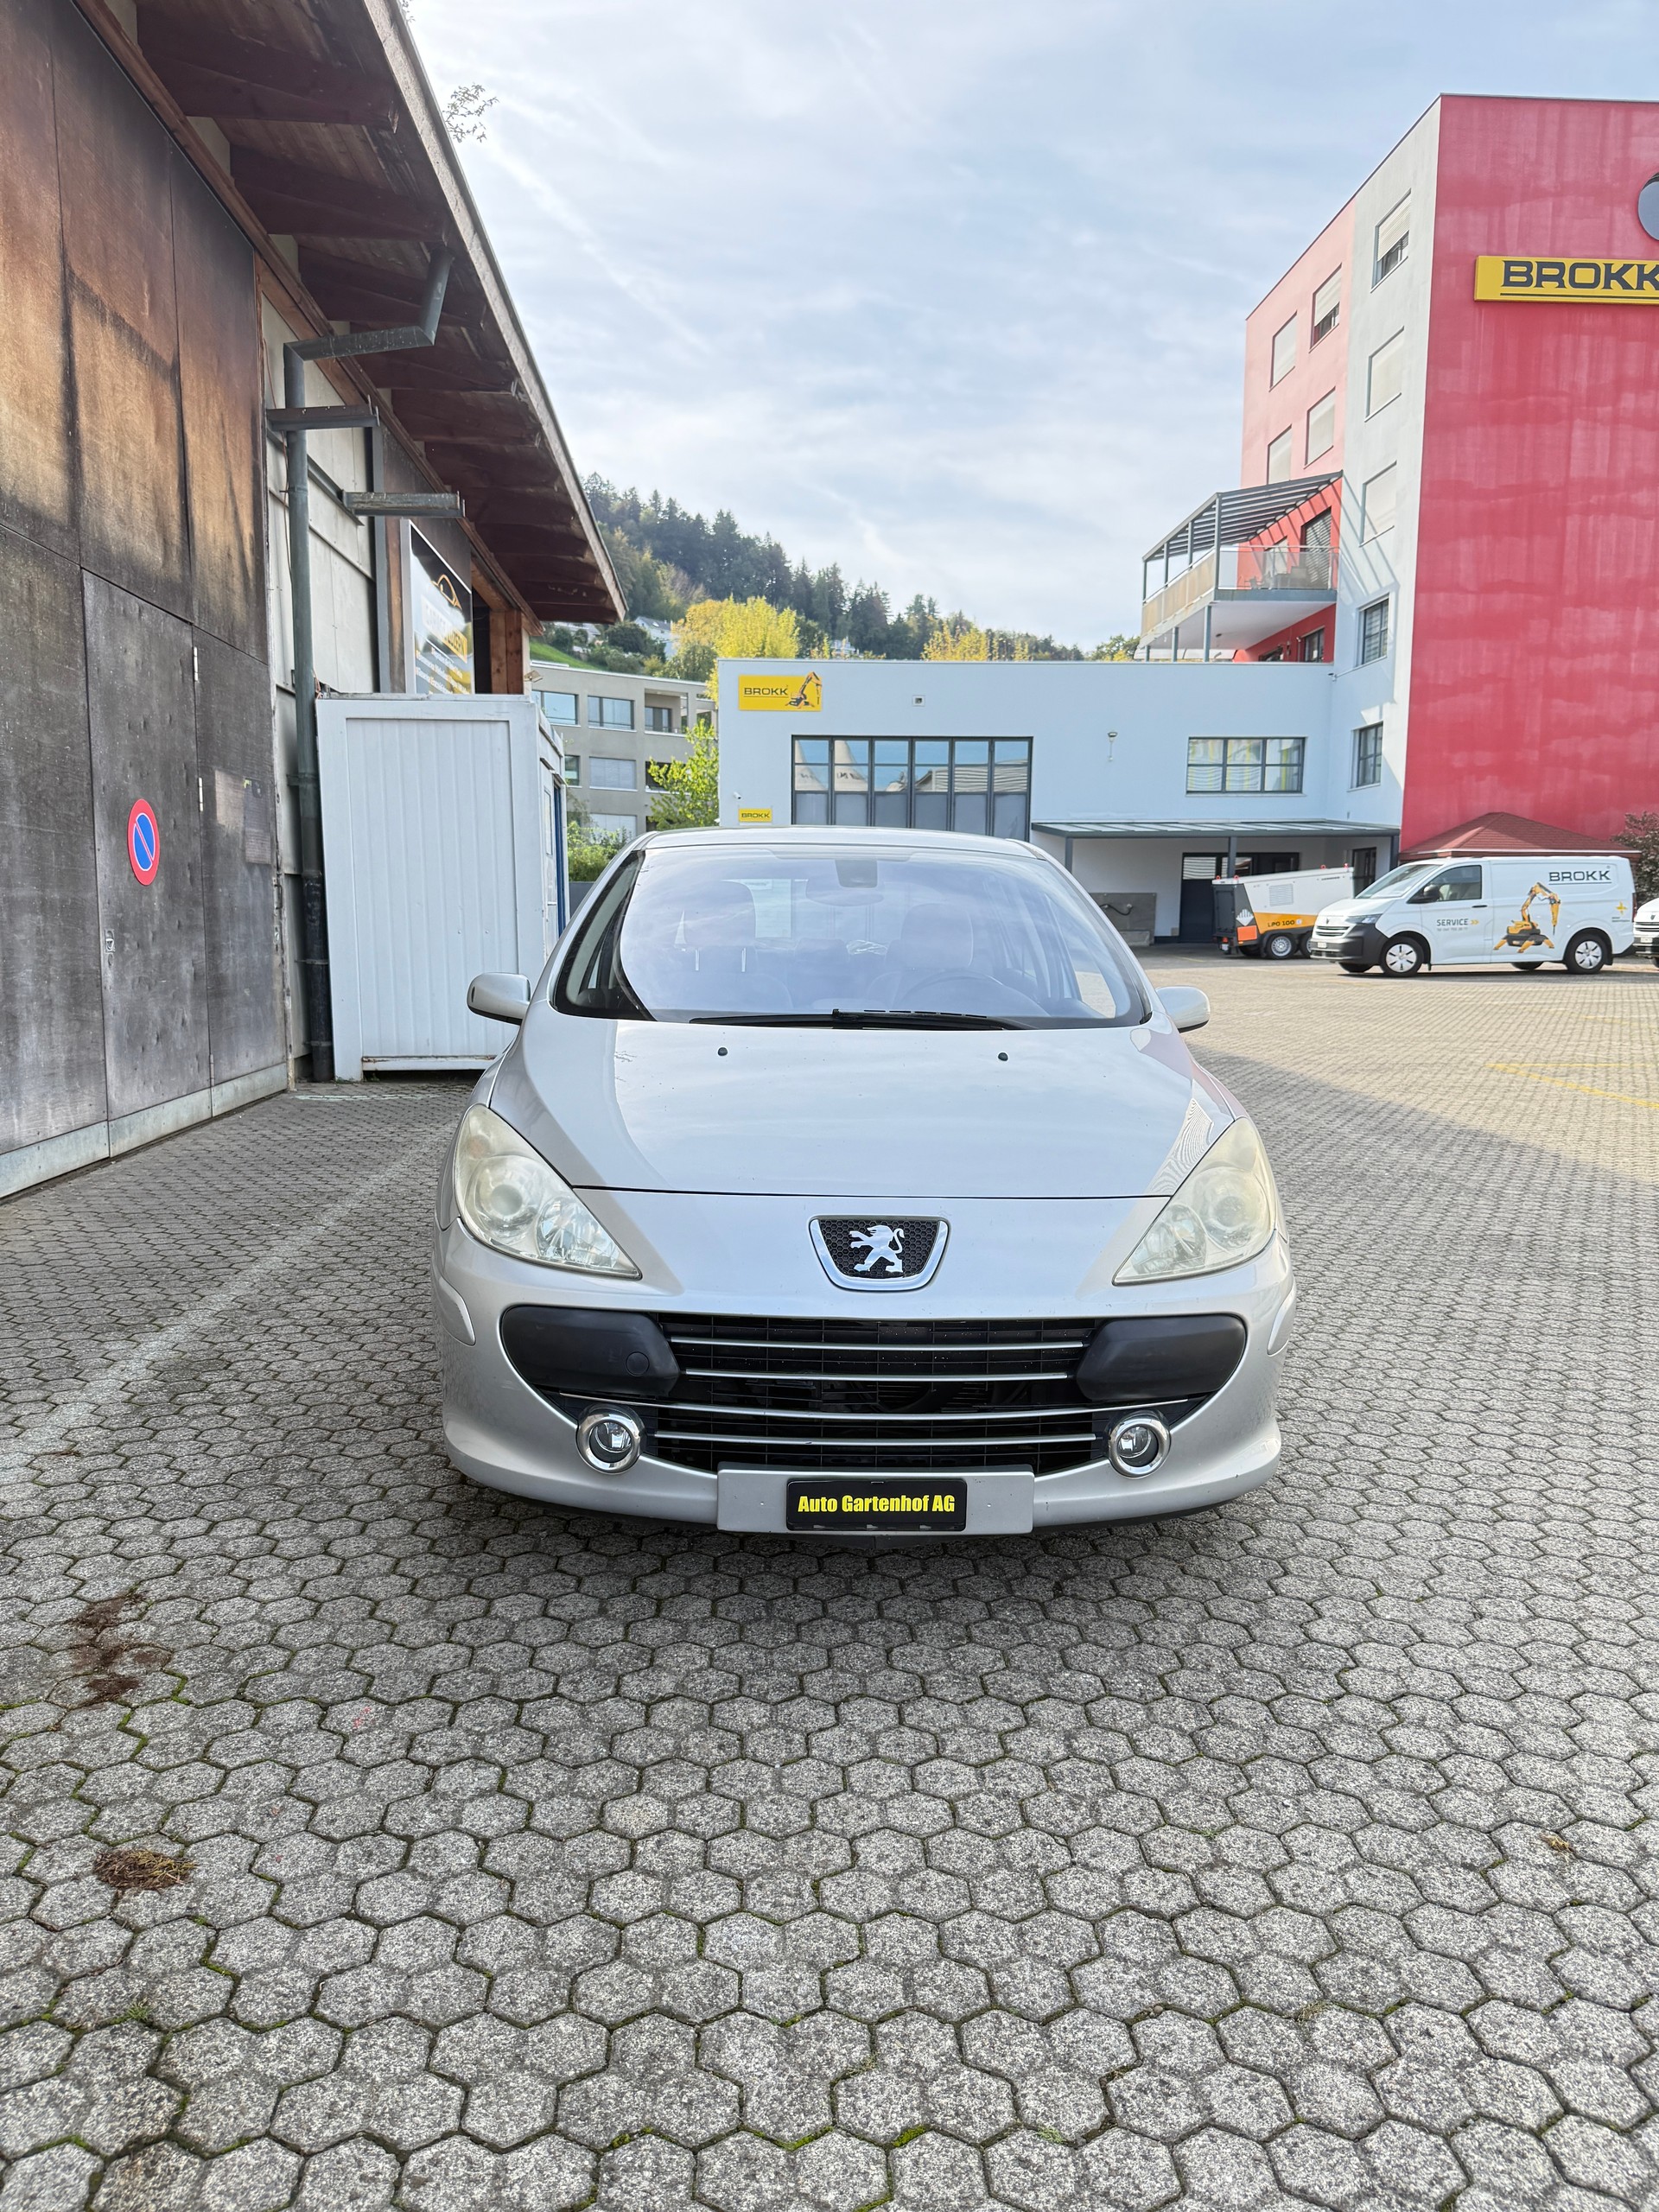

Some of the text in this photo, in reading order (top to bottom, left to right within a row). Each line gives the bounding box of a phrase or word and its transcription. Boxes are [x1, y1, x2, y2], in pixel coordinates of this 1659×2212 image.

[1501, 260, 1659, 290] BROKK
[744, 687, 789, 696] BROKK
[1548, 870, 1611, 882] BROKK
[798, 1495, 955, 1512] Auto Gartenhof AG
